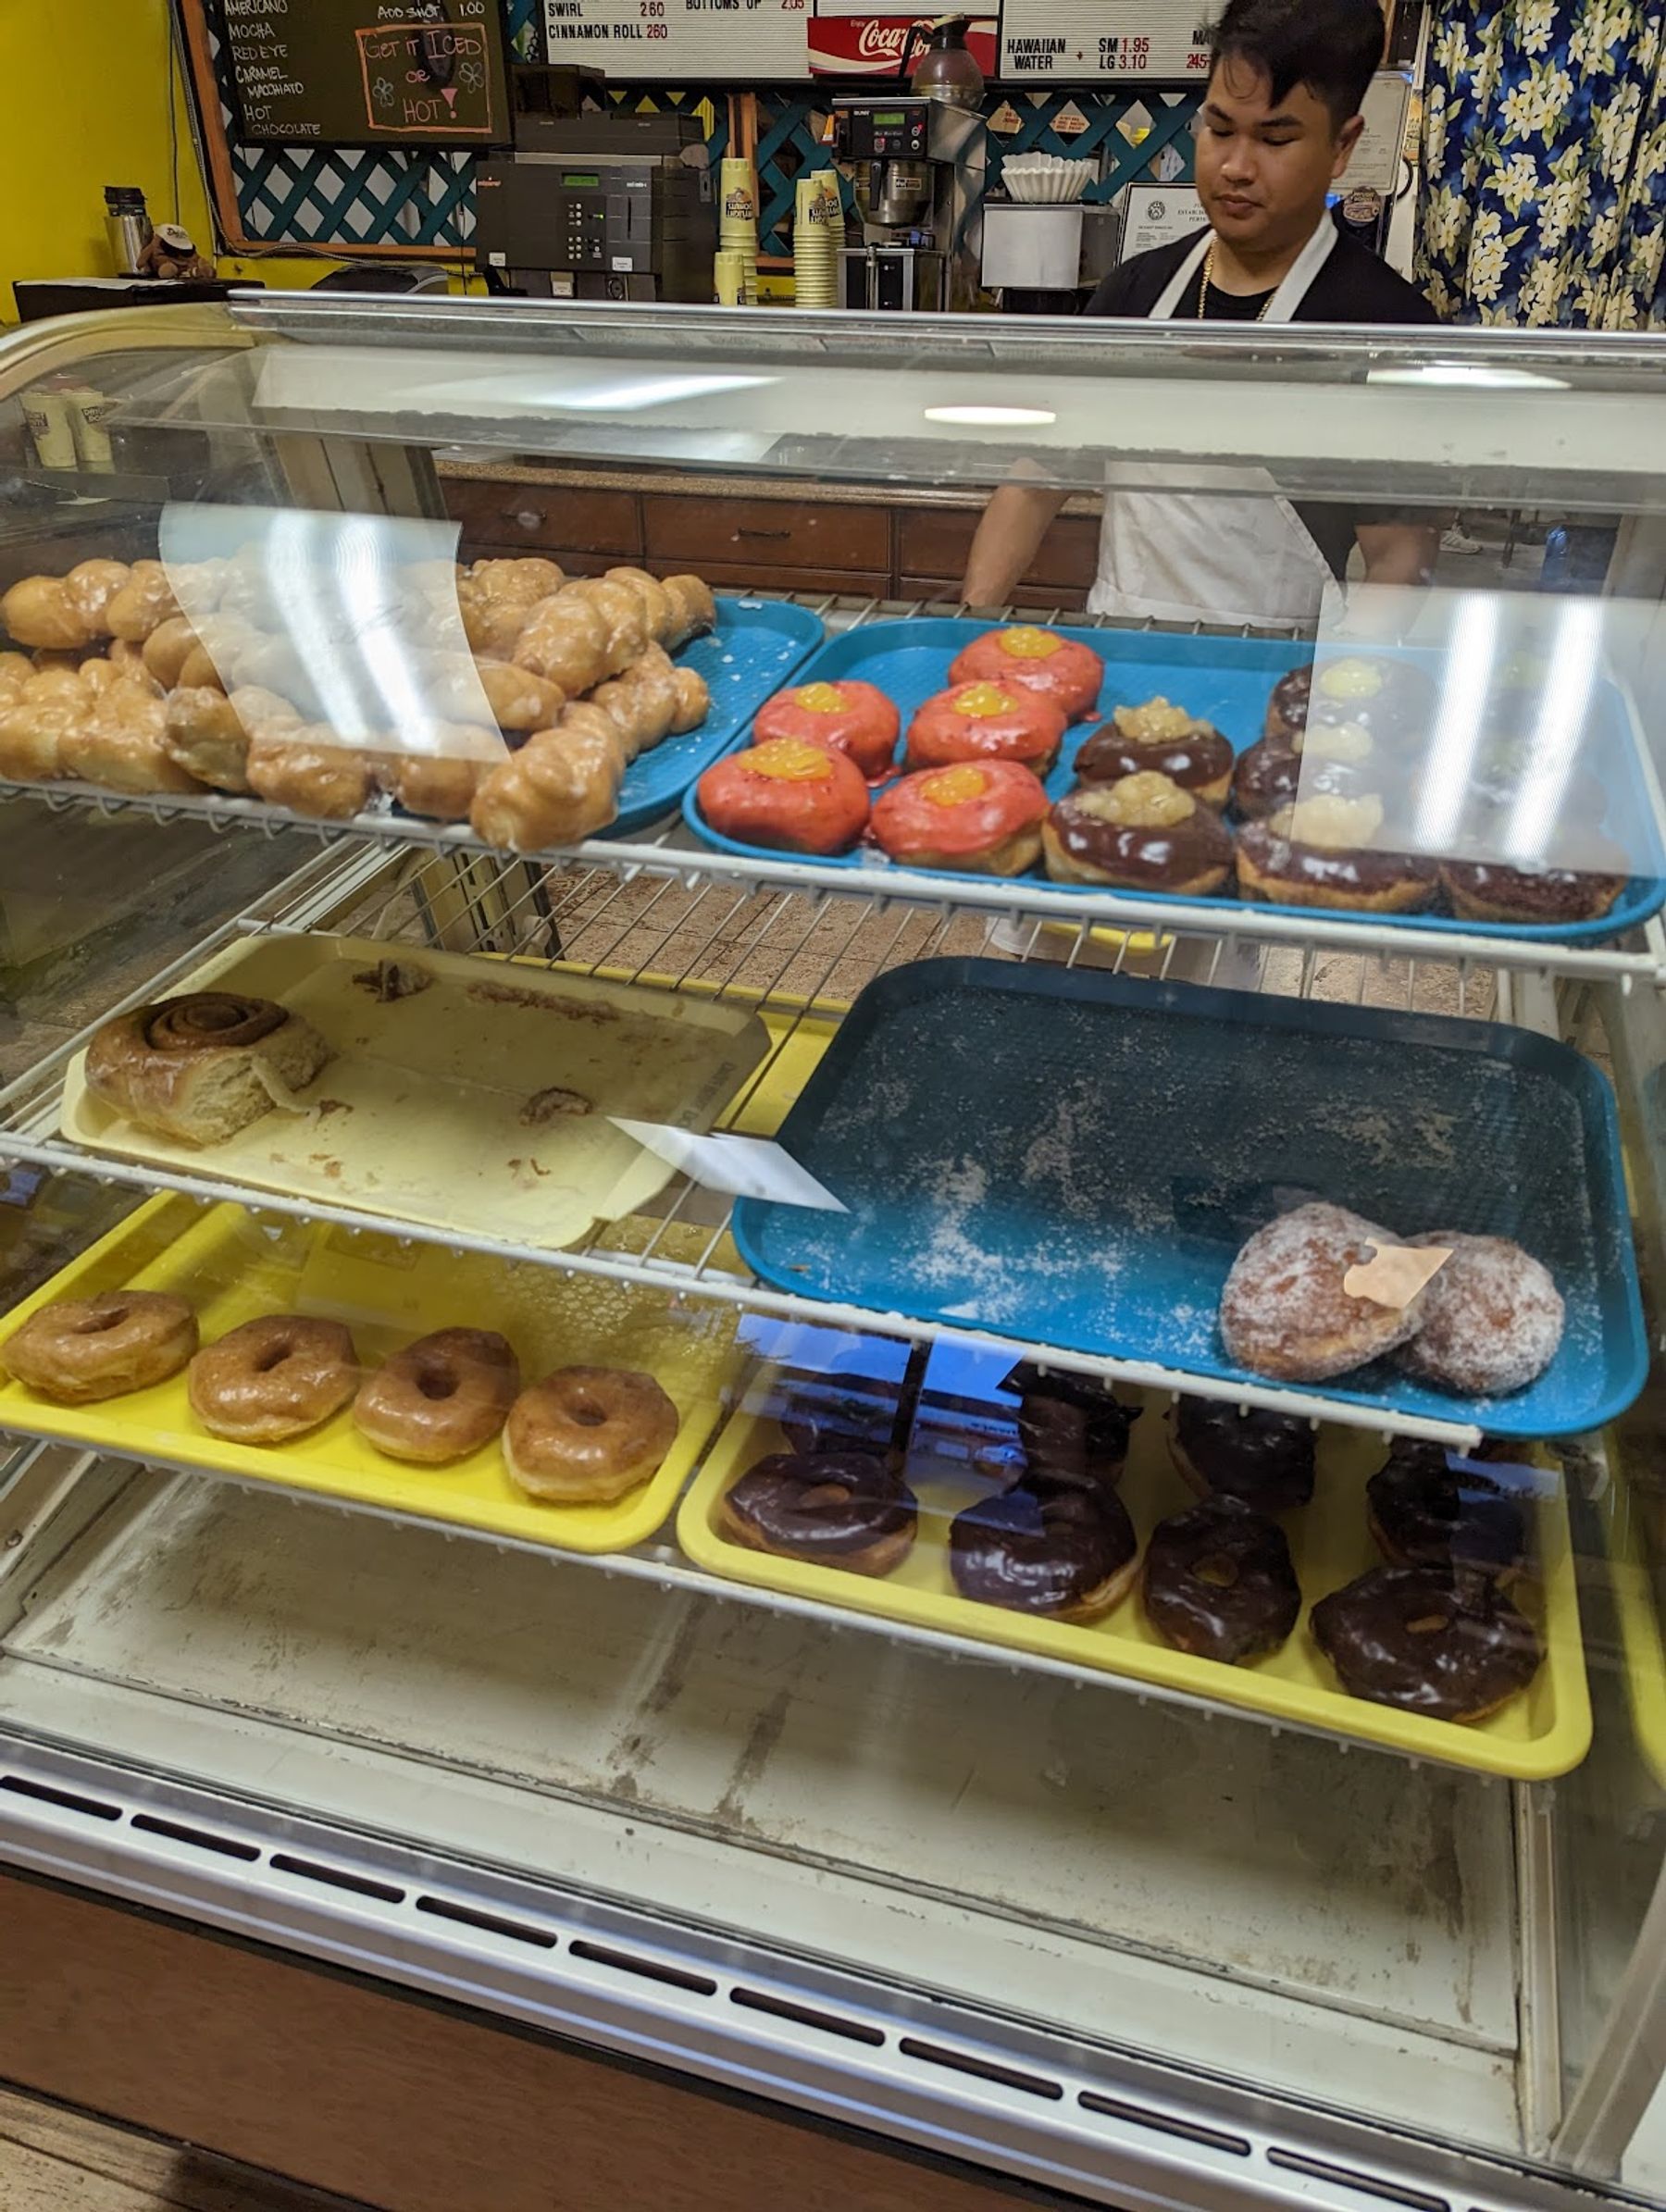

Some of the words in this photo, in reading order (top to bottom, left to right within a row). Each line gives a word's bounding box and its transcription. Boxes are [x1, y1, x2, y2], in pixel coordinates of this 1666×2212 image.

[224, 0, 288, 16] AMERICANO
[378, 6, 404, 19] ADD
[459, 2, 484, 17] 1.00
[548, 3, 583, 17] SWIRL
[228, 22, 276, 41] MOCHA
[548, 24, 609, 39] CINNAMON
[614, 24, 642, 39] ROLL
[427, 30, 481, 59] ICED
[1007, 38, 1066, 54] HAWAIIAN
[1099, 38, 1118, 53] SM
[1121, 37, 1150, 53] 1.95
[1014, 55, 1052, 69] WATER
[1099, 54, 1115, 69] LG
[1118, 54, 1147, 69] 3.10
[235, 66, 288, 83] CARAMEL
[243, 104, 272, 121] HOT
[252, 123, 321, 135] CHOCOLATE
